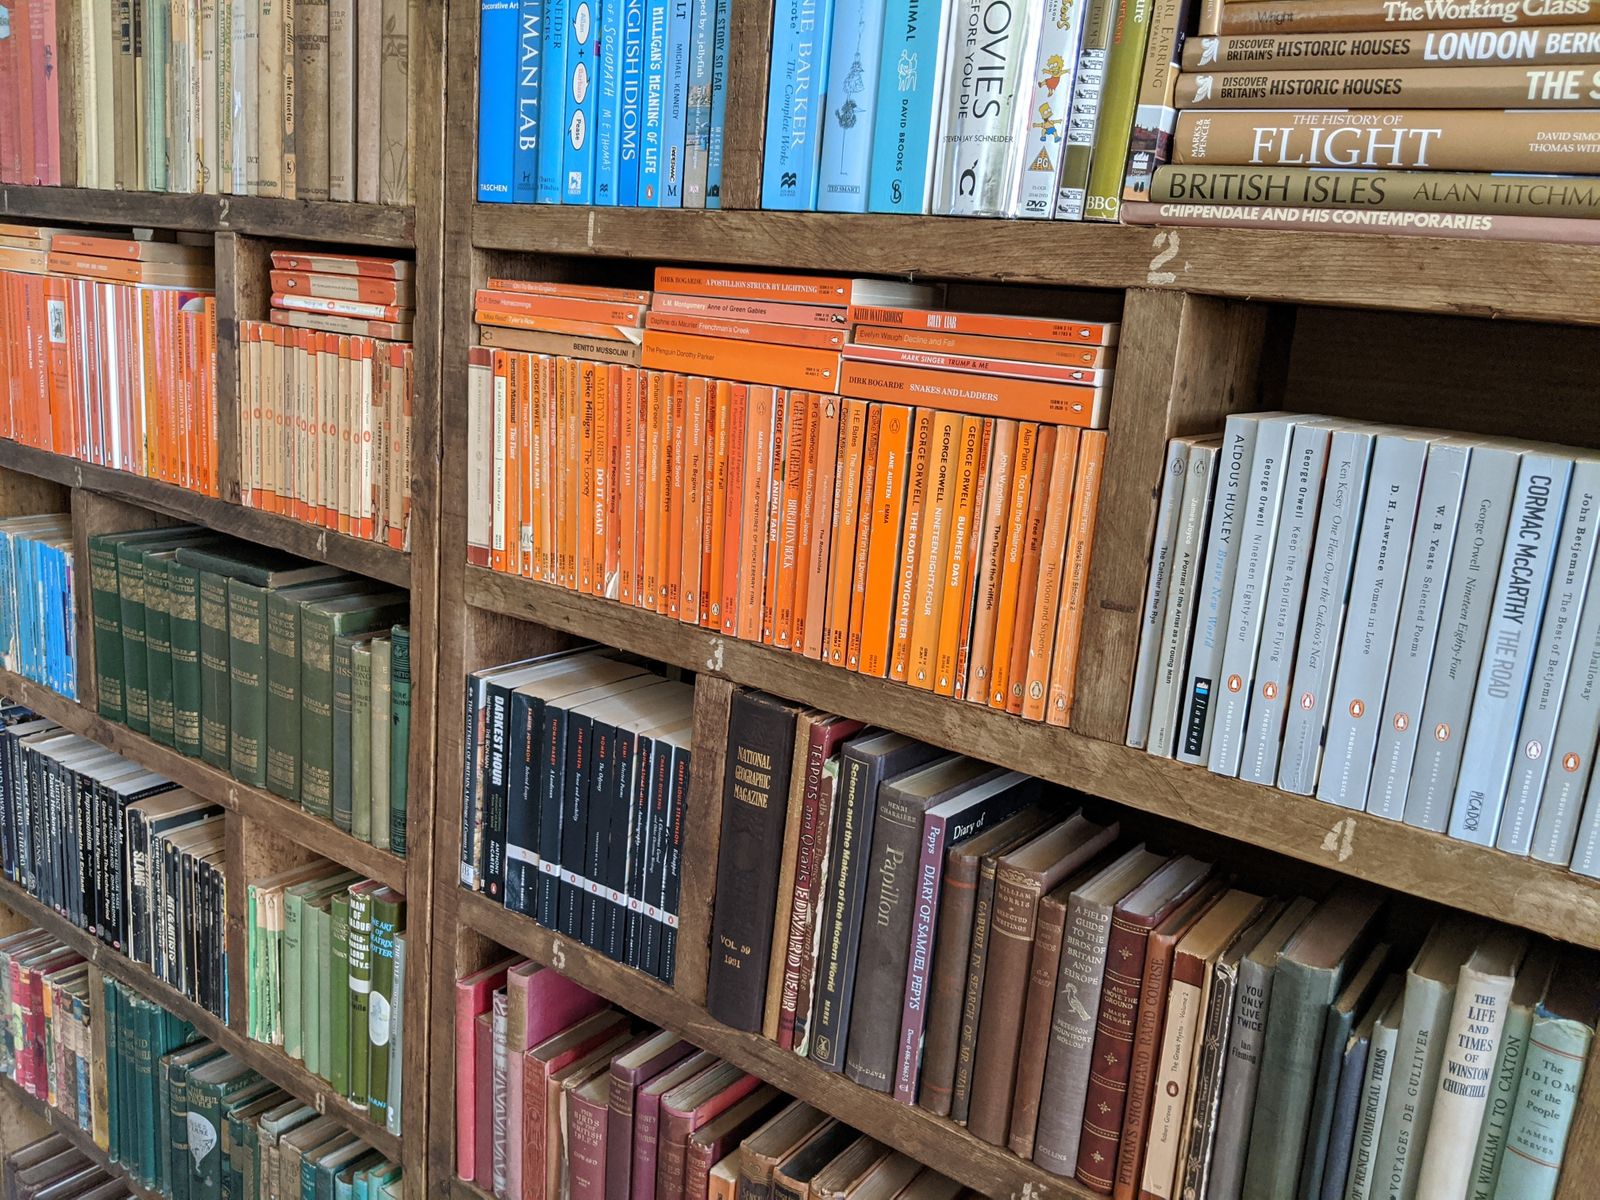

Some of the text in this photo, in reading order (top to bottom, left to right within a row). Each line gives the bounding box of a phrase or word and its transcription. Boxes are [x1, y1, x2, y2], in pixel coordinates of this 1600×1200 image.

[1228, 39, 1275, 50] DISCOVER
[1277, 38, 1410, 58] HISTORIC HOUSES
[1423, 31, 1539, 61] LONDON
[520, 14, 540, 150] MAN LAB
[644, 7, 664, 174] MILLIGAN'S MEANING OF LIFE
[672, 43, 683, 120] MICHAEL KENNEDY
[791, 43, 812, 148] BARKER
[958, 53, 974, 120] YOU DIE
[1271, 79, 1402, 96] HISTORIC HOUSES
[1526, 71, 1583, 100] THE
[622, 81, 639, 161] IDIOMS
[779, 60, 796, 165] The Complete Works
[1294, 115, 1403, 125] THE HISTORY OF
[895, 99, 908, 172] DAVID BROOKS
[1198, 118, 1212, 158] SPENCER
[1249, 128, 1442, 167] FLIGHT
[481, 184, 507, 193] TASCHEN
[1086, 196, 1118, 210] BBC
[1170, 173, 1290, 201] BRITISH
[1303, 176, 1387, 205] ISLES
[1412, 182, 1482, 202] ALAN
[219, 198, 230, 227] 2
[1159, 204, 1492, 231] CHIPPENDALE AND HIS CONTEMPORARIES
[1147, 230, 1180, 286] 2
[927, 314, 957, 329] BILLY LIAR
[573, 343, 628, 358] BENITO MUSSOLINI
[900, 353, 919, 362] MARK
[921, 354, 945, 365] SINGER
[948, 358, 970, 368] TRUMP
[978, 362, 989, 370] ME
[38, 359, 46, 398] FLANDERS
[849, 376, 904, 390] DIRK BOGARDE
[909, 383, 999, 402] SNAKES AND LADDERS
[583, 370, 593, 438] Spike Milligan
[912, 417, 929, 506] GEORGE ORWELL
[936, 425, 952, 503] GEORGE ORWELL
[959, 426, 976, 508] GEORGE ORWELL
[1019, 429, 1032, 471] Alan Paton
[1219, 435, 1246, 543] ALDOUS HUXLEY
[1256, 458, 1274, 527] George Orwell
[1295, 448, 1313, 518] George Orwell
[1332, 461, 1350, 509] Ken Kesey
[783, 499, 798, 568] BRIGHTON ROCK
[951, 516, 966, 586] BURMESE DAYS
[1468, 499, 1492, 571] George Orwell
[1502, 475, 1553, 624] CORMAC McCARTHY
[1566, 494, 1593, 585] John Betjeman
[923, 508, 943, 615] NINETEEN EIGHTY-FOUR
[1237, 534, 1263, 642] Nineteen Eighty-Four
[1409, 577, 1432, 658] Selected Poems
[1487, 630, 1522, 699] THE ROAD
[491, 695, 504, 786] DARKEST HOUR
[737, 747, 771, 770] NATIONAL
[733, 783, 768, 809] MAGAZINE
[734, 765, 771, 789] GEOGRAPHIC
[84, 791, 93, 851] Impressionism
[1463, 791, 1484, 832] PICADOR
[1320, 817, 1357, 862] 4
[133, 850, 145, 886] SLANG
[780, 744, 822, 1011] TEAPOTS and Quails EDWARD LEAR
[876, 844, 904, 927] Papillon
[908, 825, 941, 1010] Pepys DIARY OF SAMUEL PEPYS
[1075, 918, 1104, 933] GUIDE
[552, 938, 566, 970] 5
[1067, 947, 1102, 965] BRITAIN
[1064, 968, 1098, 985] EUROPE
[821, 1000, 831, 1026] MARKS
[1241, 997, 1264, 1009] ONLY
[1467, 1007, 1496, 1023] LIFE
[1474, 994, 1496, 1006] THE
[1236, 1016, 1263, 1032] TWICE
[1458, 1034, 1493, 1052] TIMES
[1468, 1024, 1489, 1035] AND
[1118, 958, 1164, 1186] PITMAN'S SHORTHAND RAPID COURSE
[1448, 1060, 1490, 1081] WINSTON
[1542, 1059, 1564, 1074] The
[316, 1092, 326, 1115] 8
[1360, 1049, 1388, 1148] COMMERCIAL TERMS
[1443, 1078, 1486, 1098] CHURCHILL
[1389, 1030, 1429, 1191] VOYAGES DE GULLIVER
[1527, 1100, 1560, 1120] People
[1352, 1149, 1370, 1186] FRENCH
